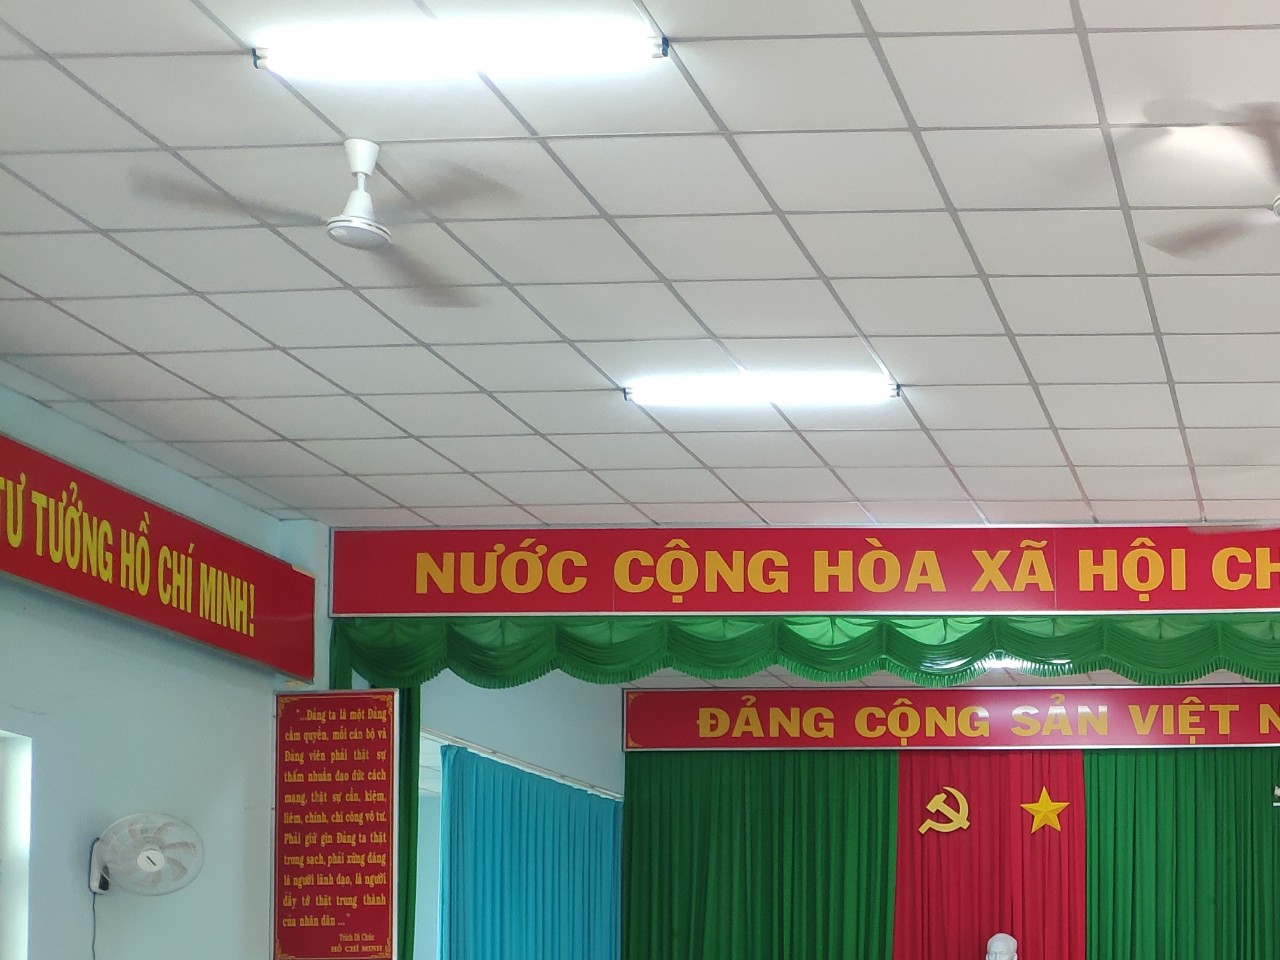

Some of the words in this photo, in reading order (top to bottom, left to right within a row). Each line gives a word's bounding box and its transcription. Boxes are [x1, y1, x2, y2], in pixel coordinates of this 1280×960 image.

[0, 472, 26, 548] Ư
[31, 481, 114, 584] TƯỞNG
[121, 511, 151, 597] HỒ
[158, 543, 194, 614] CHÍ
[200, 562, 256, 638] MINH!
[415, 537, 588, 594] NƯỚC
[613, 538, 789, 603] CỘNG
[813, 537, 947, 593] HÒA
[971, 540, 1054, 592] XÃ
[1078, 537, 1186, 602] HỘI
[697, 694, 835, 739] ĐẢNG
[855, 697, 990, 746] CỘNG
[1011, 693, 1109, 736] SẢN
[1128, 696, 1239, 744] VIỆT
